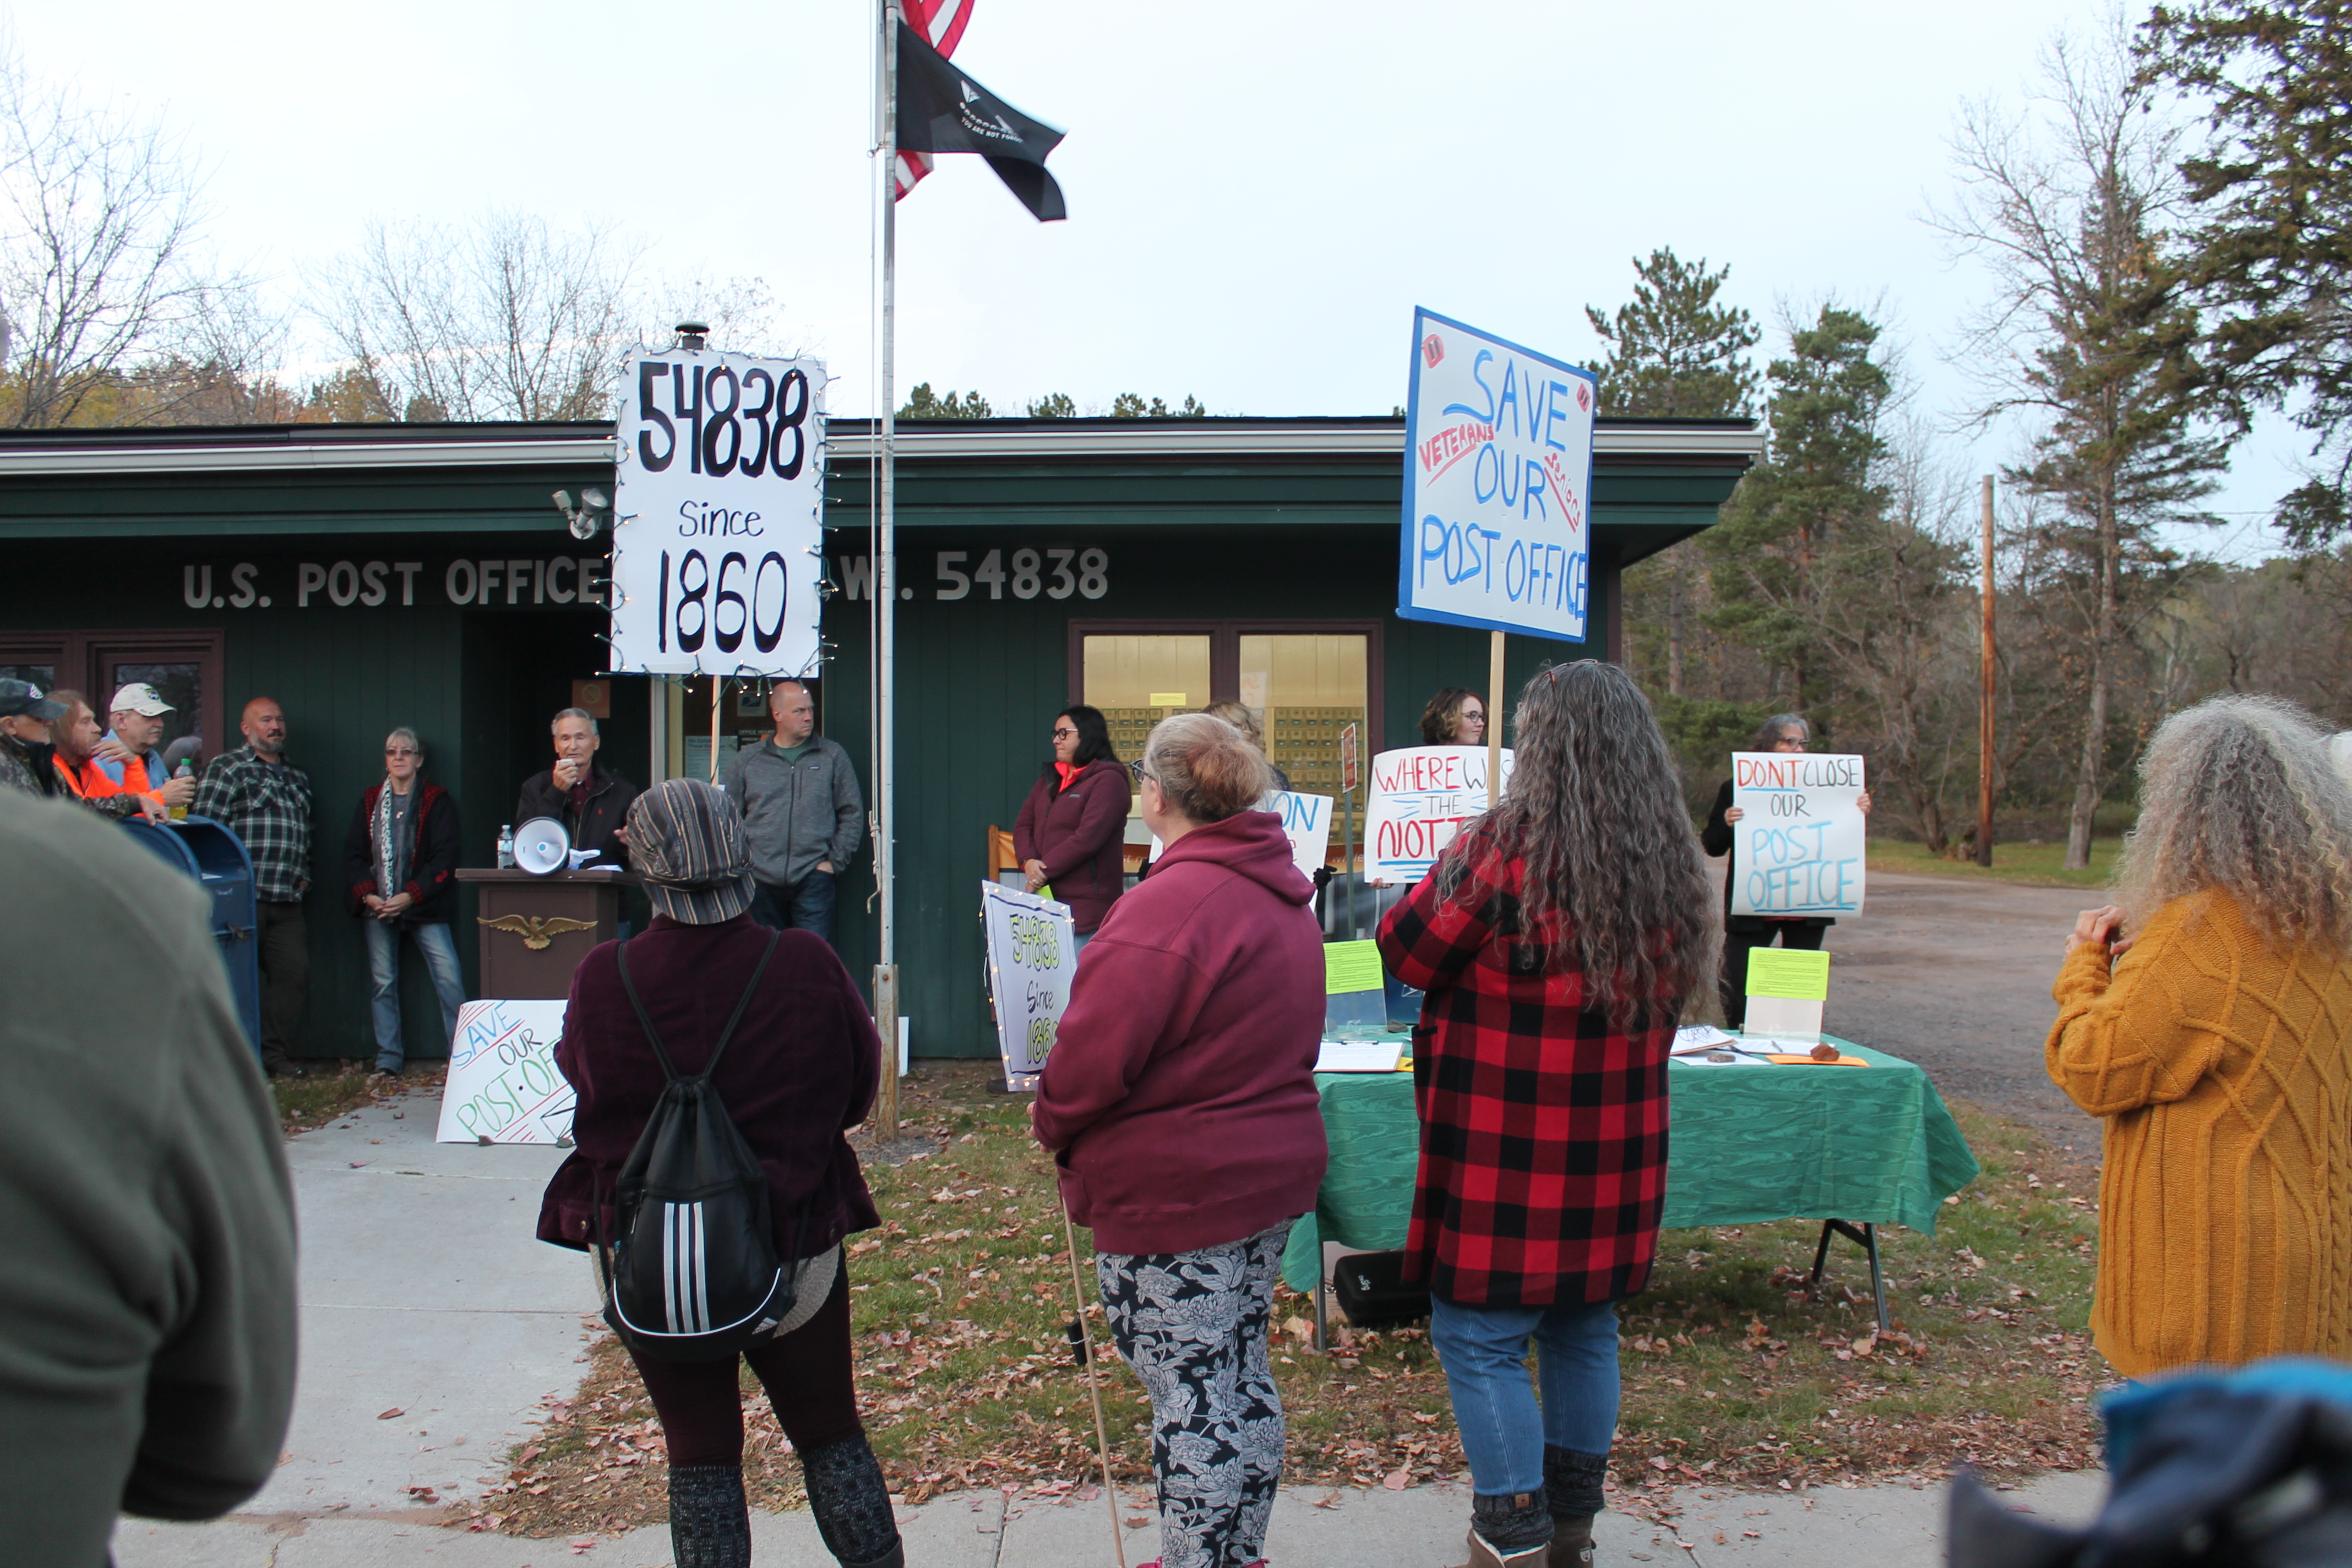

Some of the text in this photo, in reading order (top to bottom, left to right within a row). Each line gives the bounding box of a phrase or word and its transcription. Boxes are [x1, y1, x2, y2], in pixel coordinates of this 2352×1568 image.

[639, 362, 808, 480] 54838
[1442, 349, 1567, 453] SAVE
[1418, 423, 1494, 473] VETERANS
[1475, 443, 1546, 522] OUR
[679, 500, 764, 537] Since
[184, 548, 1108, 608] U.S. POST OFFICE W. 54838
[1420, 514, 1586, 620] POST OFFICE
[658, 548, 787, 653] 1860
[1375, 756, 1461, 792] WHERE
[1738, 758, 1860, 787] DONT CLOSE
[1425, 794, 1464, 815] THE
[1771, 794, 1811, 817] OUR
[1753, 821, 1832, 866] POST
[1747, 858, 1859, 908] OFFICE
[1009, 913, 1060, 971] 54838
[1027, 980, 1054, 1014] Since
[451, 1000, 522, 1066] SAVE
[498, 1028, 543, 1065] OUR
[456, 1069, 525, 1139] POST
